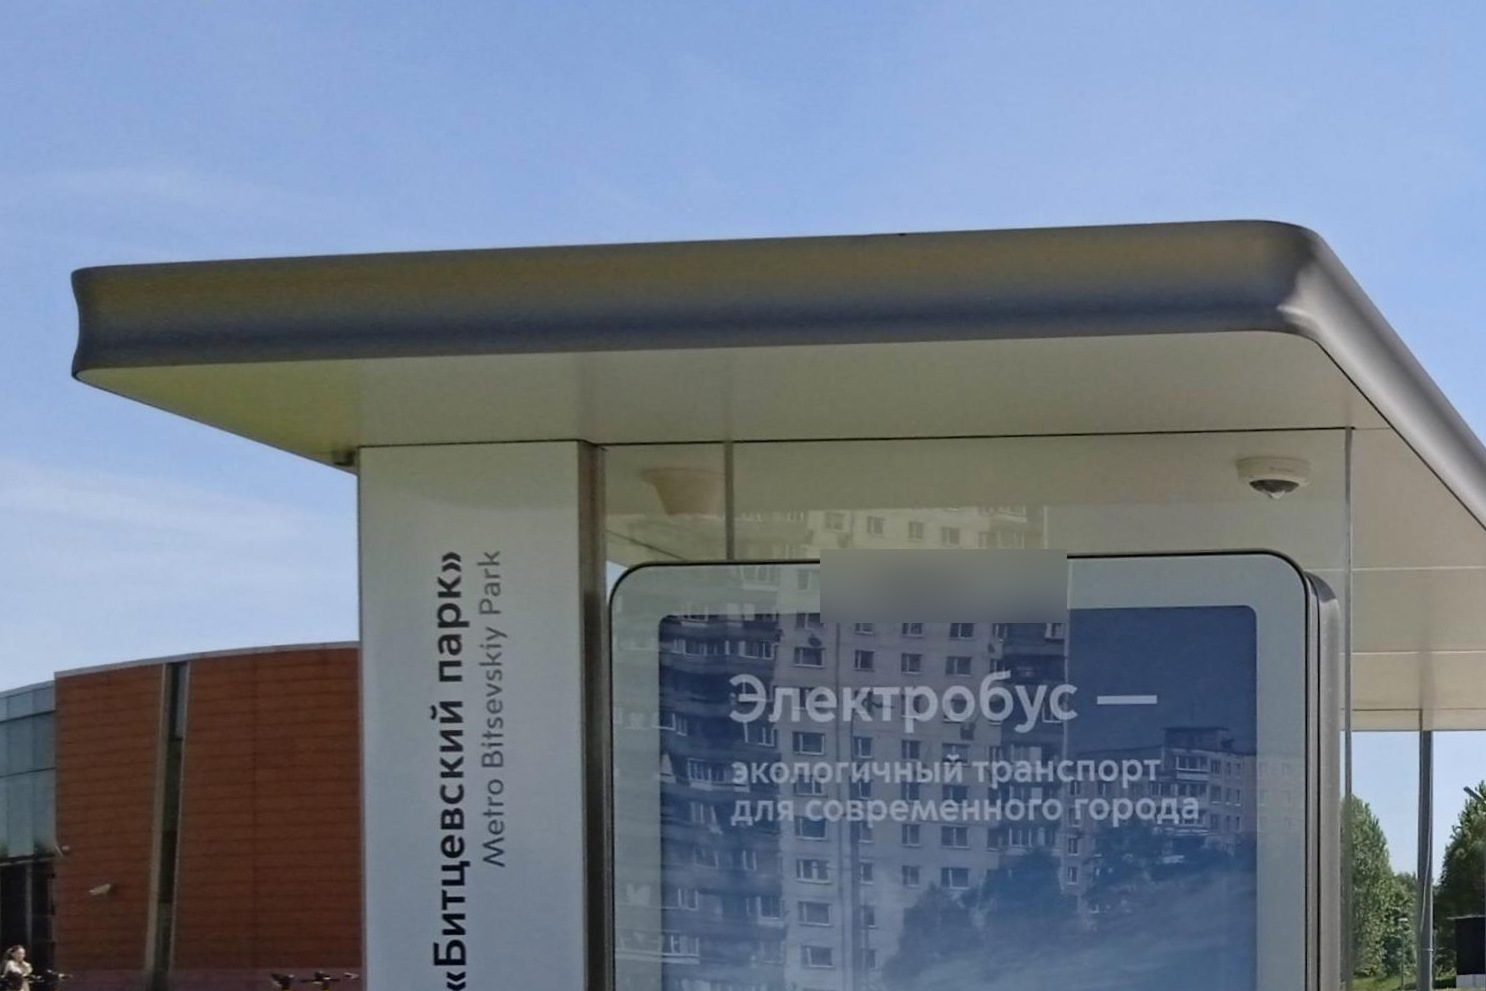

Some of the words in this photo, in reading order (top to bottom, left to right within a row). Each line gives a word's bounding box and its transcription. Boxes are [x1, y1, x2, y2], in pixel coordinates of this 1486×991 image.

[479, 550, 501, 615] Park
[436, 550, 471, 684] парк»
[480, 627, 508, 767] Bitsevskiy
[728, 670, 1078, 734] Электробус
[731, 754, 963, 785] экологичный
[972, 757, 1162, 789] транспорт
[482, 779, 505, 868] Metro
[731, 798, 794, 827] для
[804, 796, 1063, 826] современного
[1074, 797, 1199, 826] города
